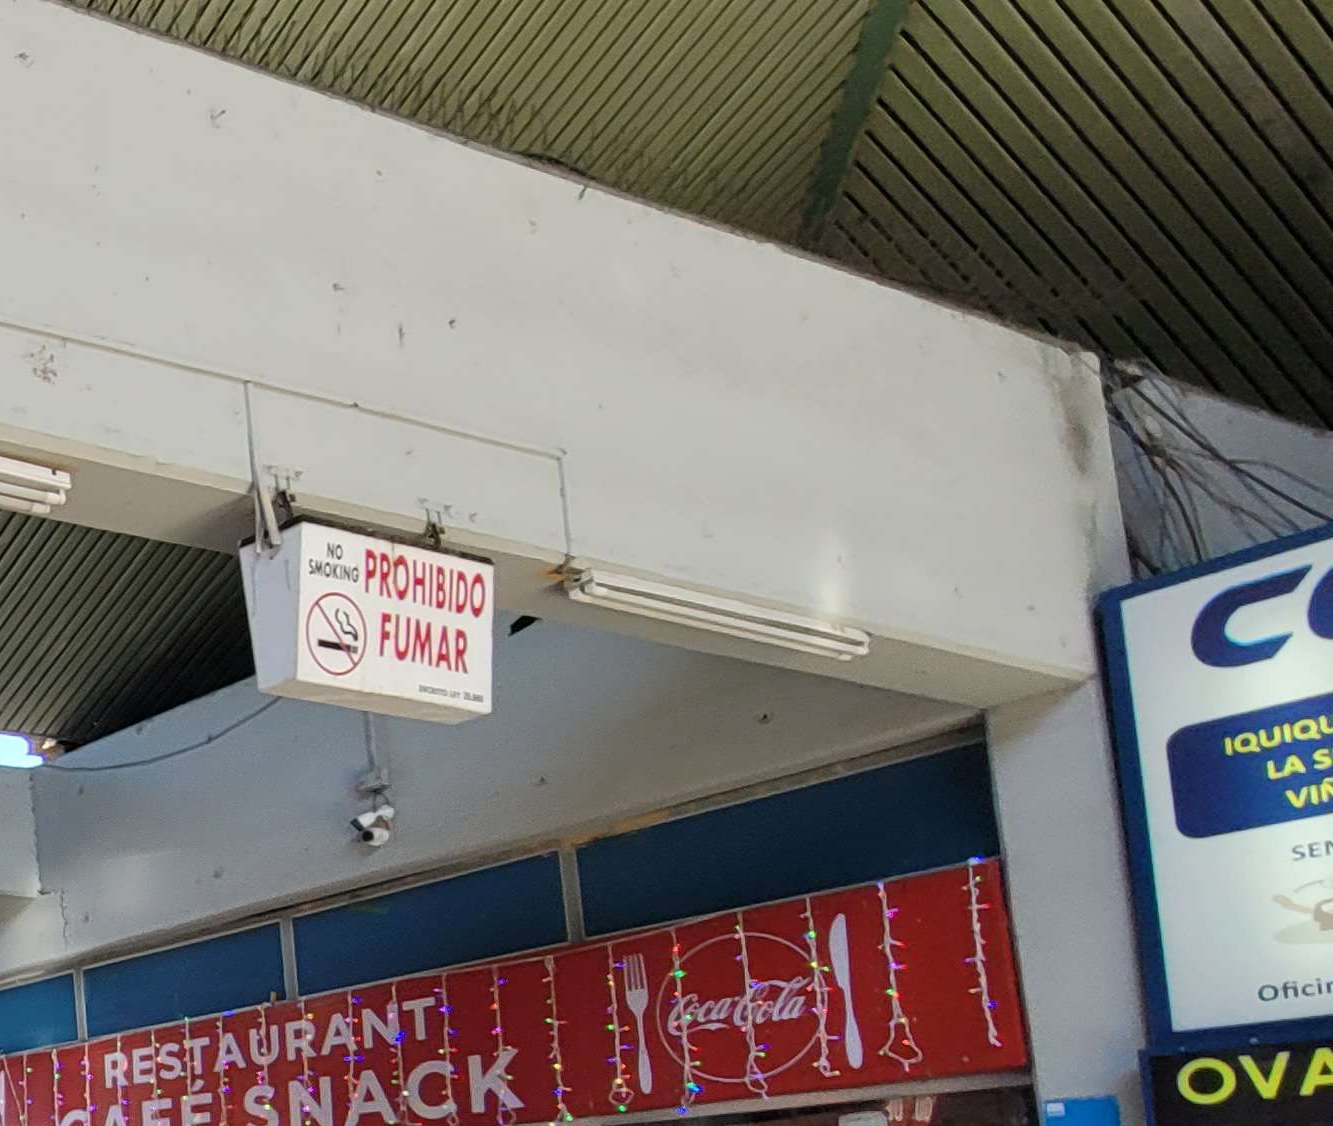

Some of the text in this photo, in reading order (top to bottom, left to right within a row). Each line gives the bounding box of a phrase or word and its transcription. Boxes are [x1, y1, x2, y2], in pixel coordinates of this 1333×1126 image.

[309, 559, 359, 583] SMOKING
[326, 542, 343, 560] NO
[365, 548, 485, 618] PROHIBIDO
[380, 612, 468, 674] FUMAR
[1266, 754, 1307, 780] LA
[104, 997, 436, 1089] RESTAURANT
